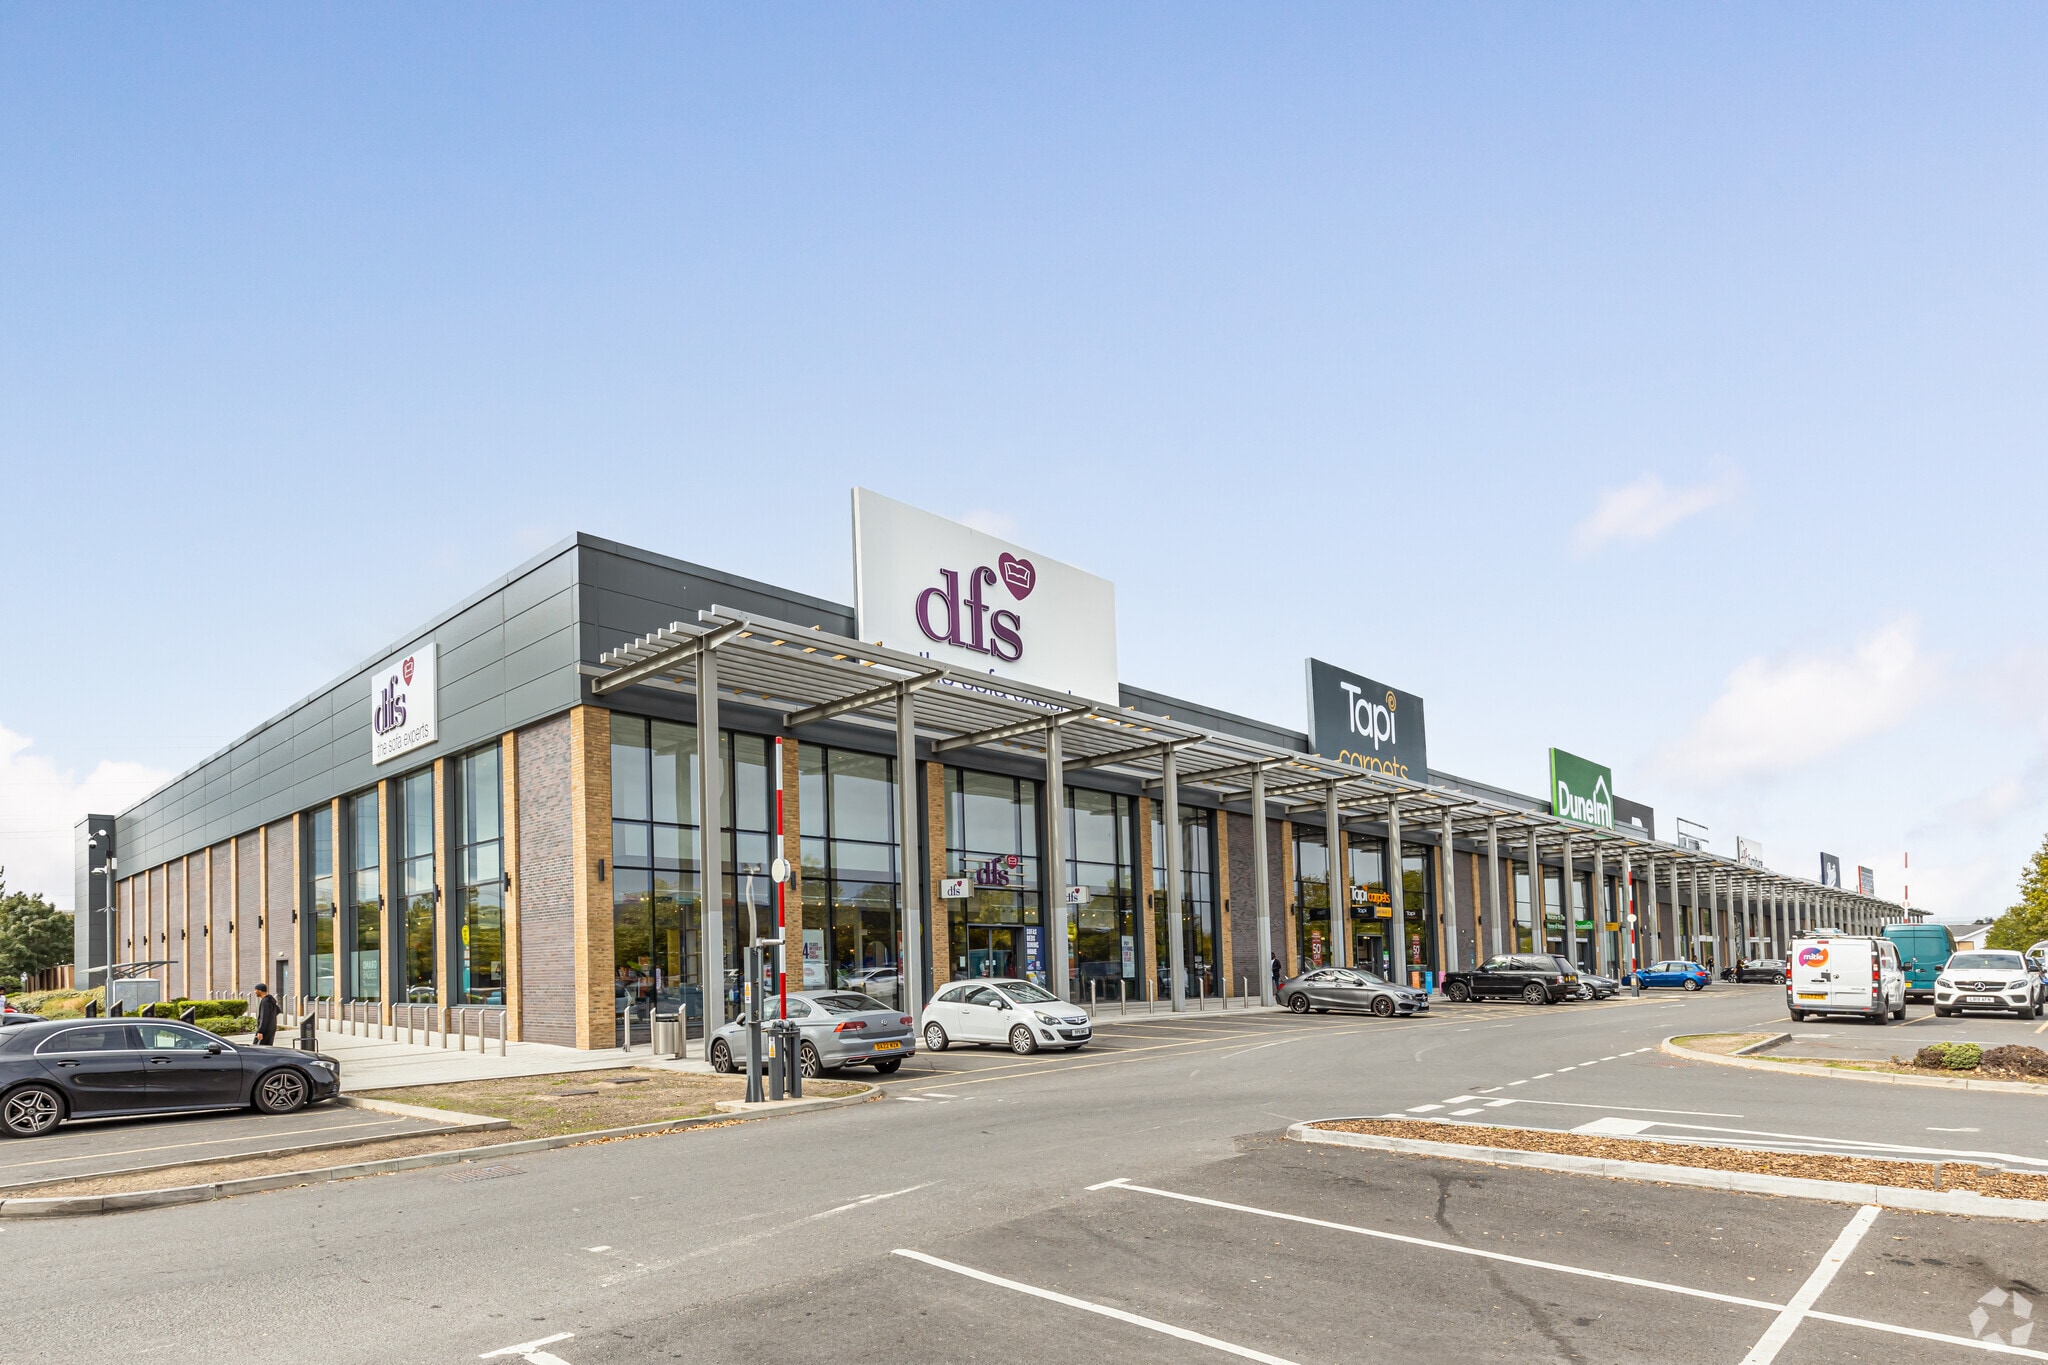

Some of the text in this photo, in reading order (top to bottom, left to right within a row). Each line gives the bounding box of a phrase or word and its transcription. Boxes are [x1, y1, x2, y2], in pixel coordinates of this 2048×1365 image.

[915, 565, 1024, 663] dfs
[374, 674, 407, 736] dfs
[1340, 681, 1397, 751] Tapi
[377, 723, 429, 757] the sofa experts
[1558, 775, 1613, 830] Dunelm
[976, 857, 1010, 887] dfs
[947, 884, 961, 897] dfs
[1066, 891, 1079, 903] dfs
[1350, 885, 1391, 905] Tapi carpets
[803, 942, 809, 959] 4
